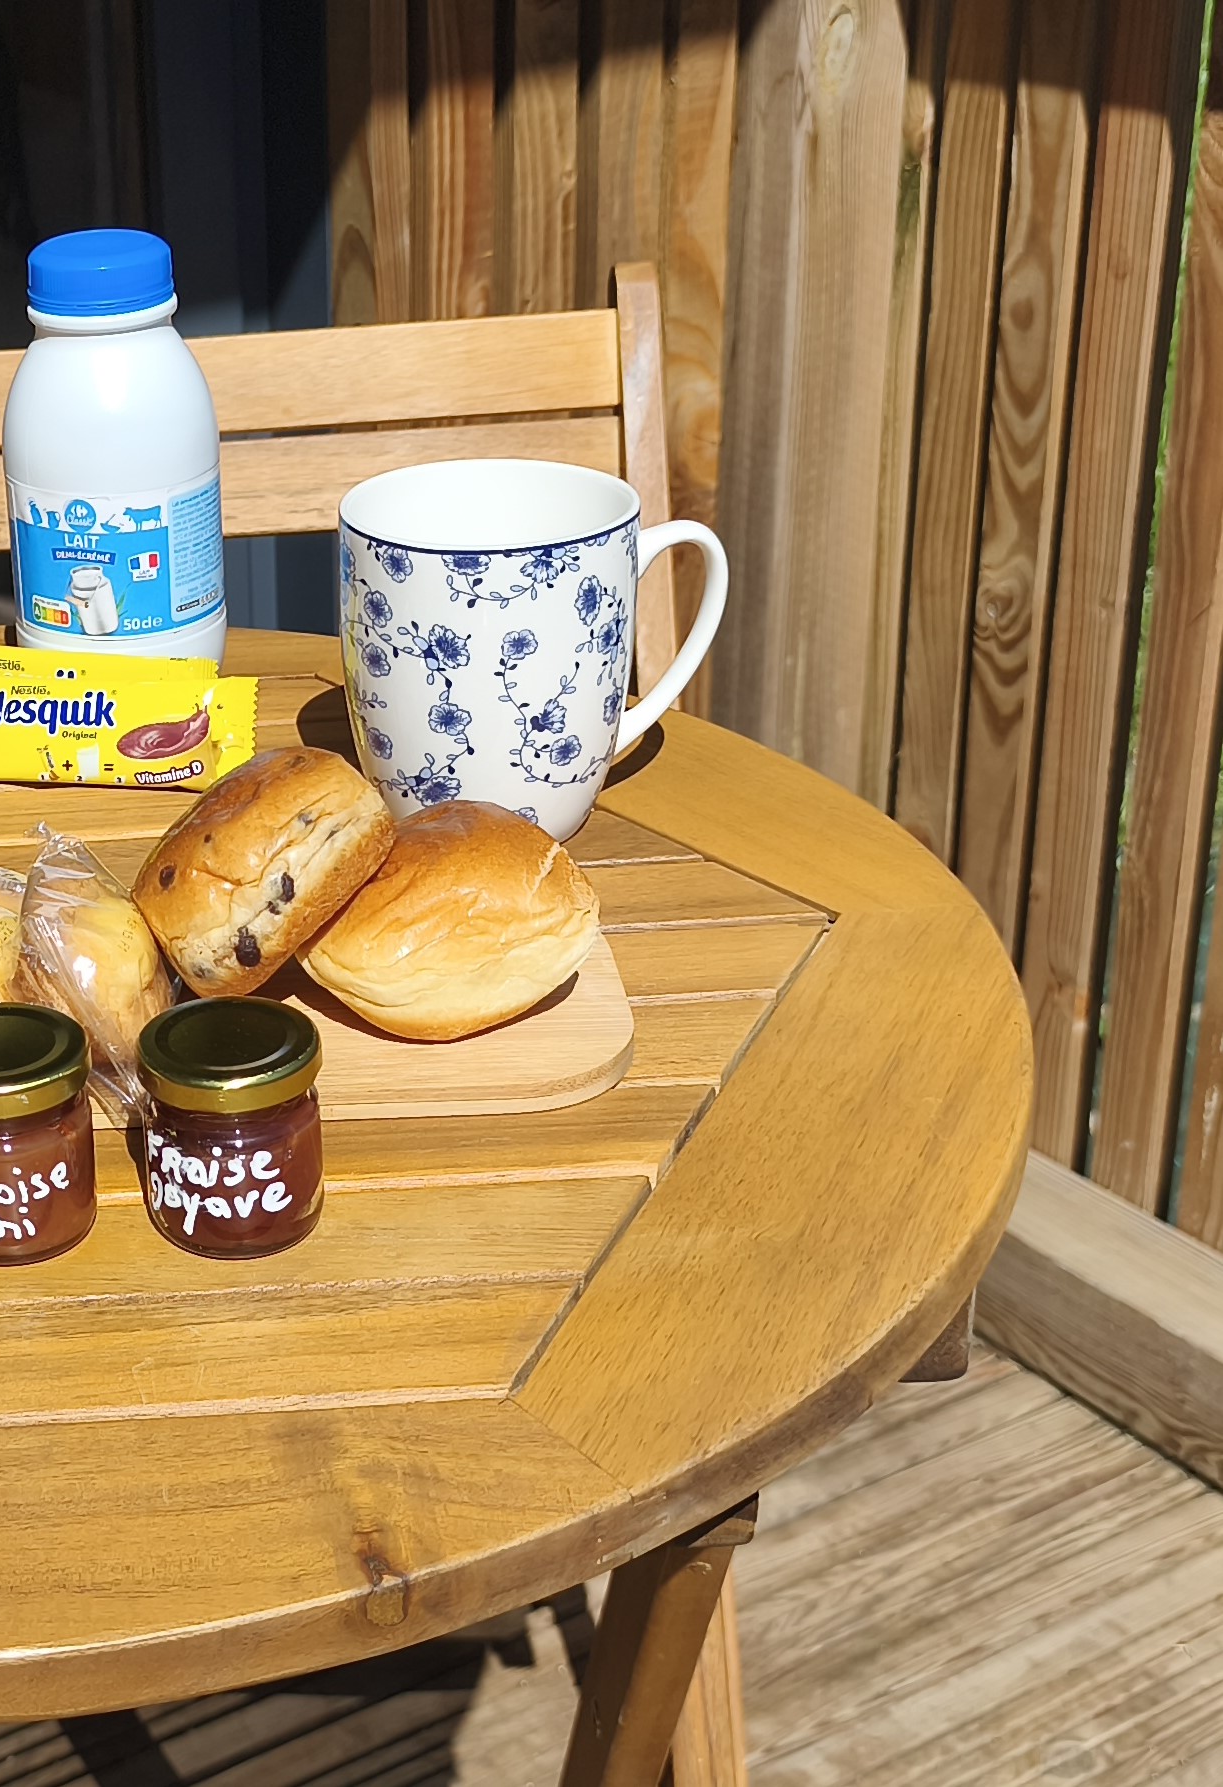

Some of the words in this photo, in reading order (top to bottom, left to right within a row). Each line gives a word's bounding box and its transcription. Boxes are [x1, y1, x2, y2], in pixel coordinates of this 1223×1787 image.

[64, 533, 100, 549] LAIT
[135, 766, 192, 784] Vitamine
[190, 761, 203, 775] D
